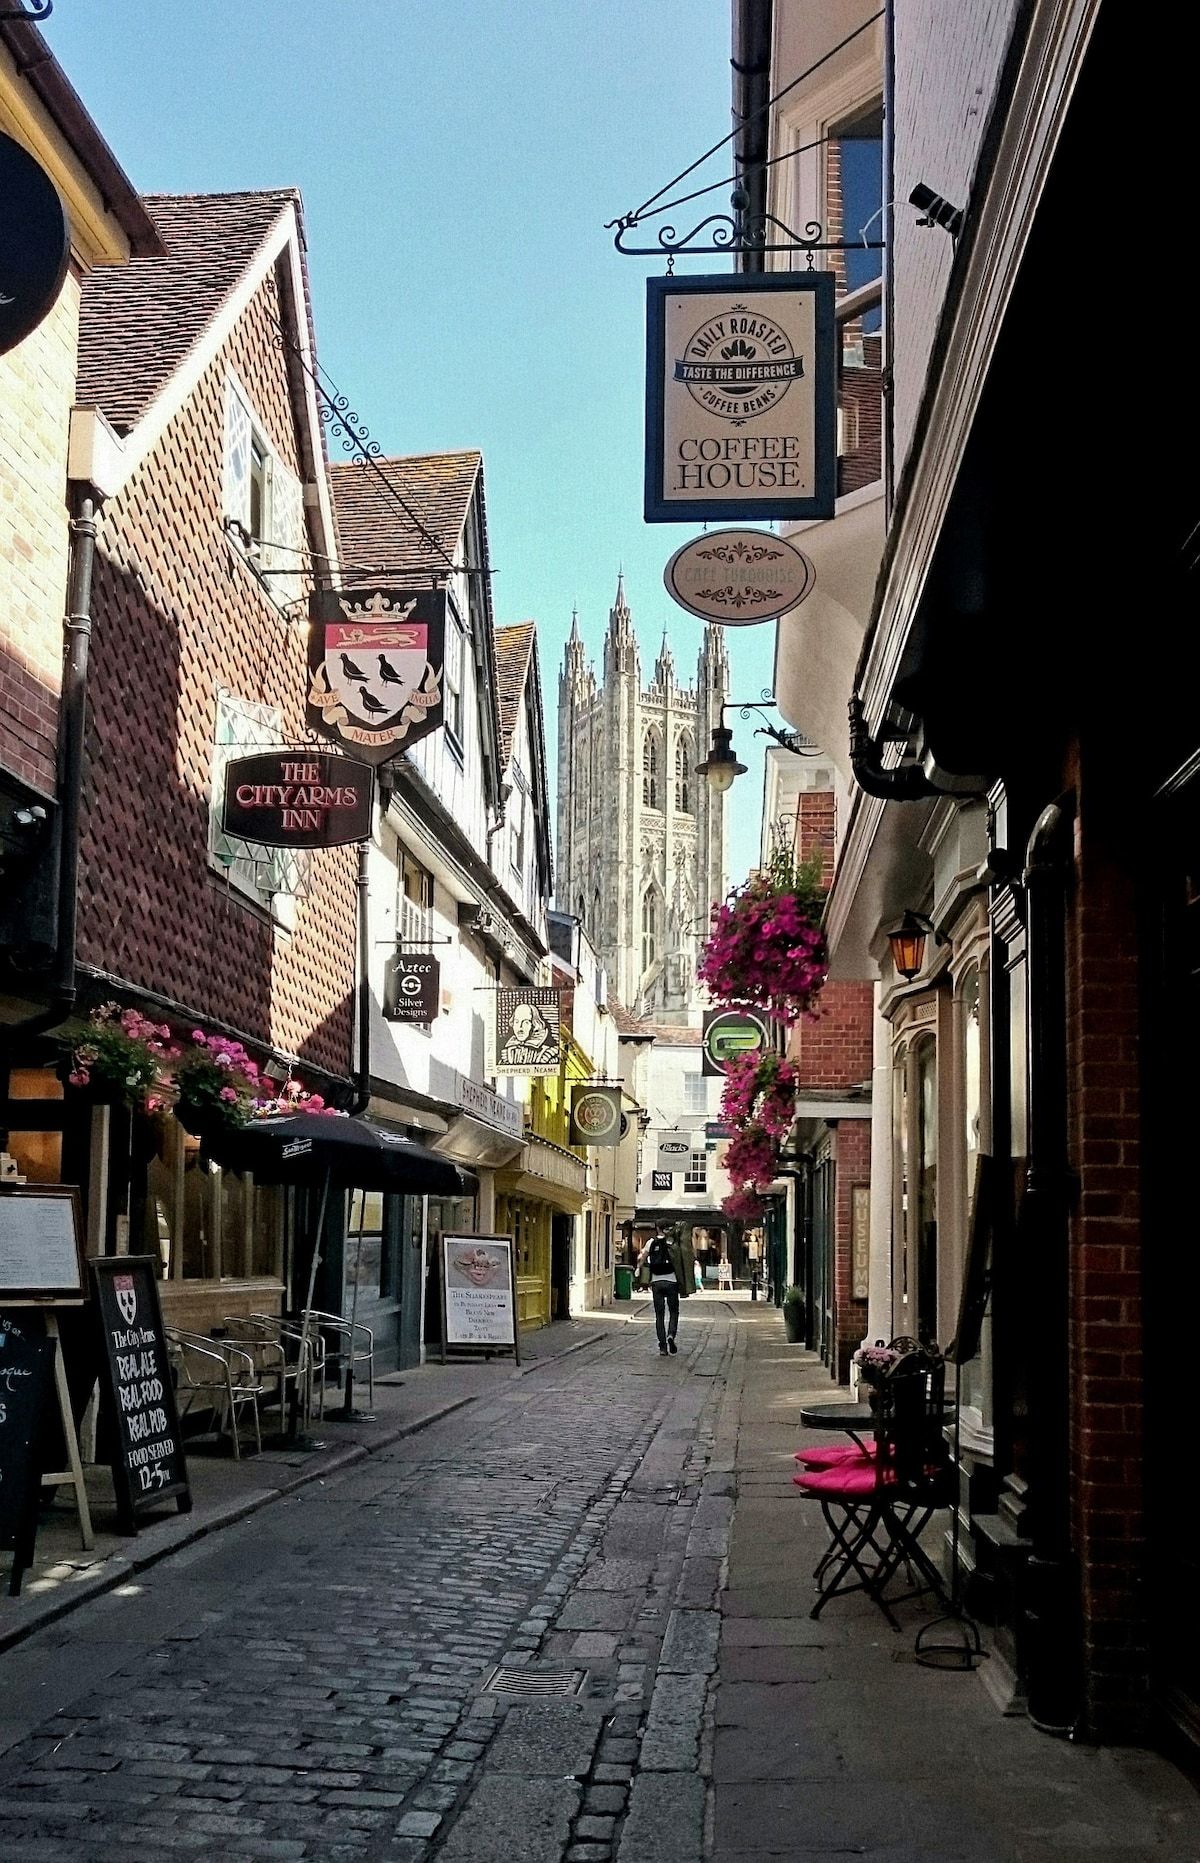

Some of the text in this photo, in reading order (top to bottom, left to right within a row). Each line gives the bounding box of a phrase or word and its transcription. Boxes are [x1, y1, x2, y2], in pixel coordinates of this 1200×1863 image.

[691, 318, 787, 358] DAILY ROASTED
[683, 363, 796, 380] TASTE THE DIFFERENCE
[702, 389, 776, 414] COFFEE BEANS
[679, 437, 800, 462] COFFEE
[678, 462, 800, 489] HOUSE
[351, 729, 396, 743] MATER
[280, 762, 319, 783] THE
[236, 784, 357, 806] CITY ARMS
[281, 809, 320, 830] INN
[392, 960, 431, 974] Aztec
[393, 1008, 428, 1018] Designs
[398, 998, 424, 1008] Silver
[497, 1066, 557, 1074] SHEPHERD NEAME
[661, 1142, 688, 1153] Blacks
[654, 1179, 671, 1188] NOA
[855, 1192, 869, 1283] MUSEUM
[112, 1330, 127, 1349] The
[126, 1329, 140, 1348] City
[116, 1350, 158, 1382] REAL ALE
[118, 1378, 163, 1412] REAL FOOD
[127, 1407, 167, 1442] REAL PUB
[127, 1438, 175, 1469] FOOD SERVED
